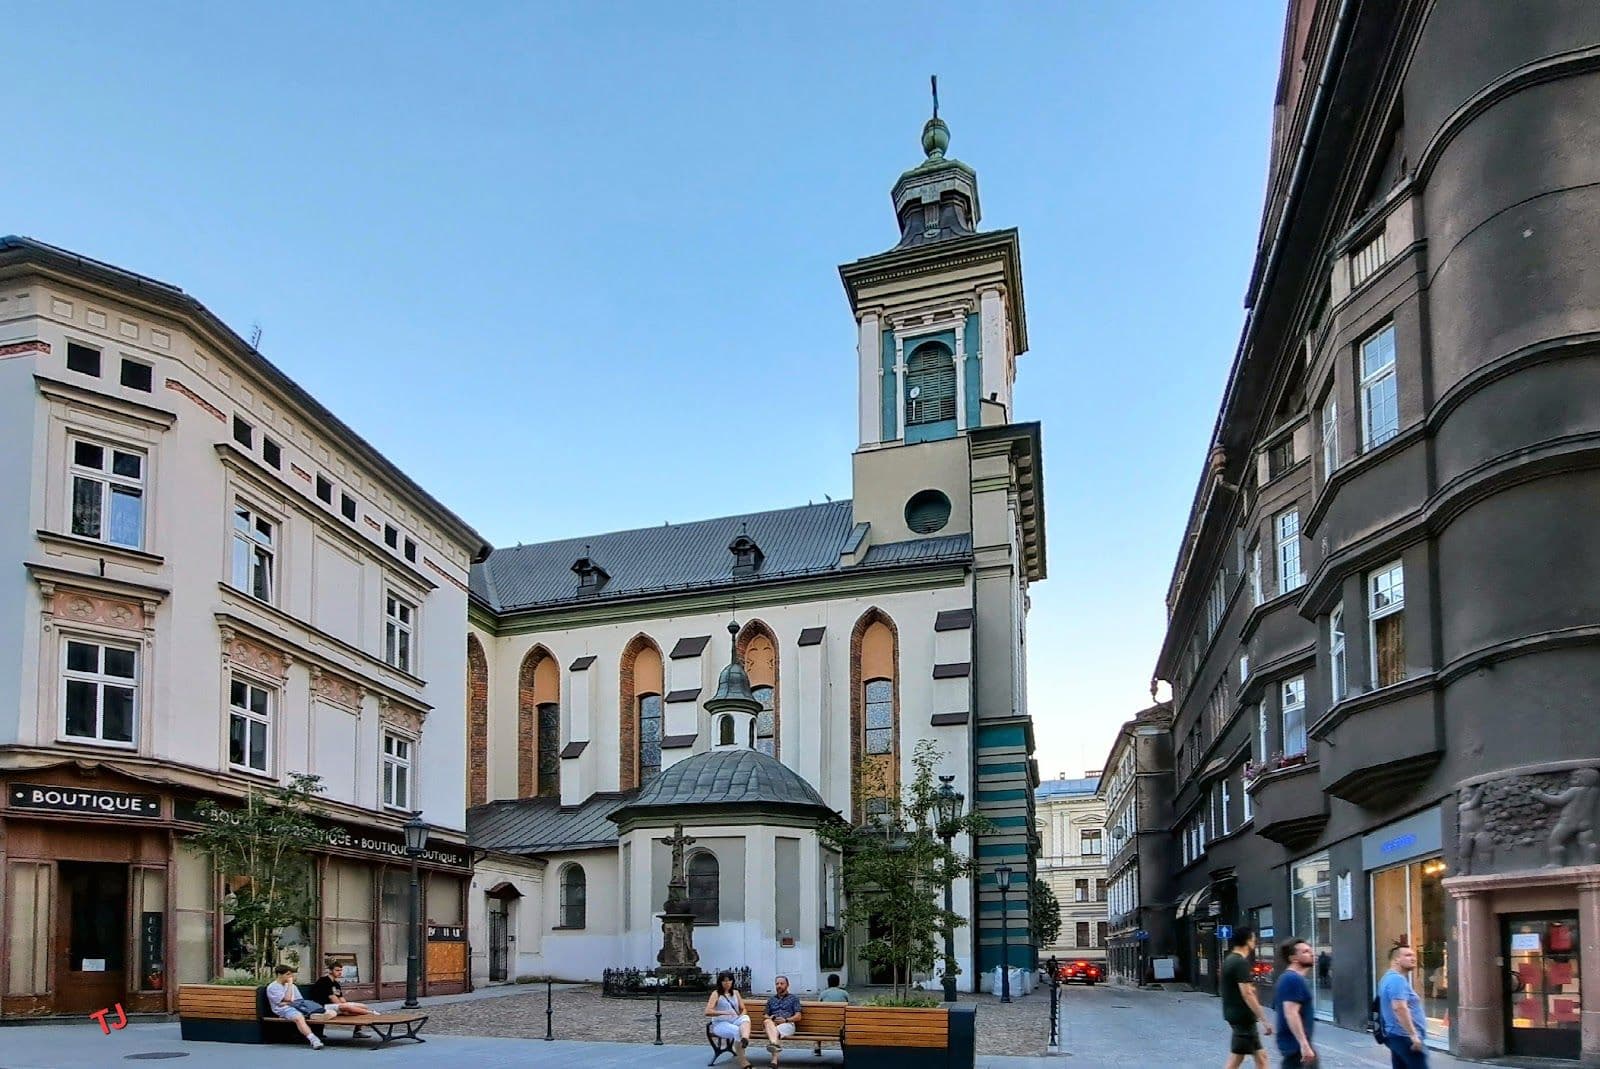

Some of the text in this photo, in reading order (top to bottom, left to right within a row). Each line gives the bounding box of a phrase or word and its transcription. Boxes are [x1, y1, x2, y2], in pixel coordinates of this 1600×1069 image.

[32, 790, 142, 811] BOUTIQUE
[361, 838, 408, 856] BOUTIQUE
[417, 849, 457, 864] OUTIQUE
